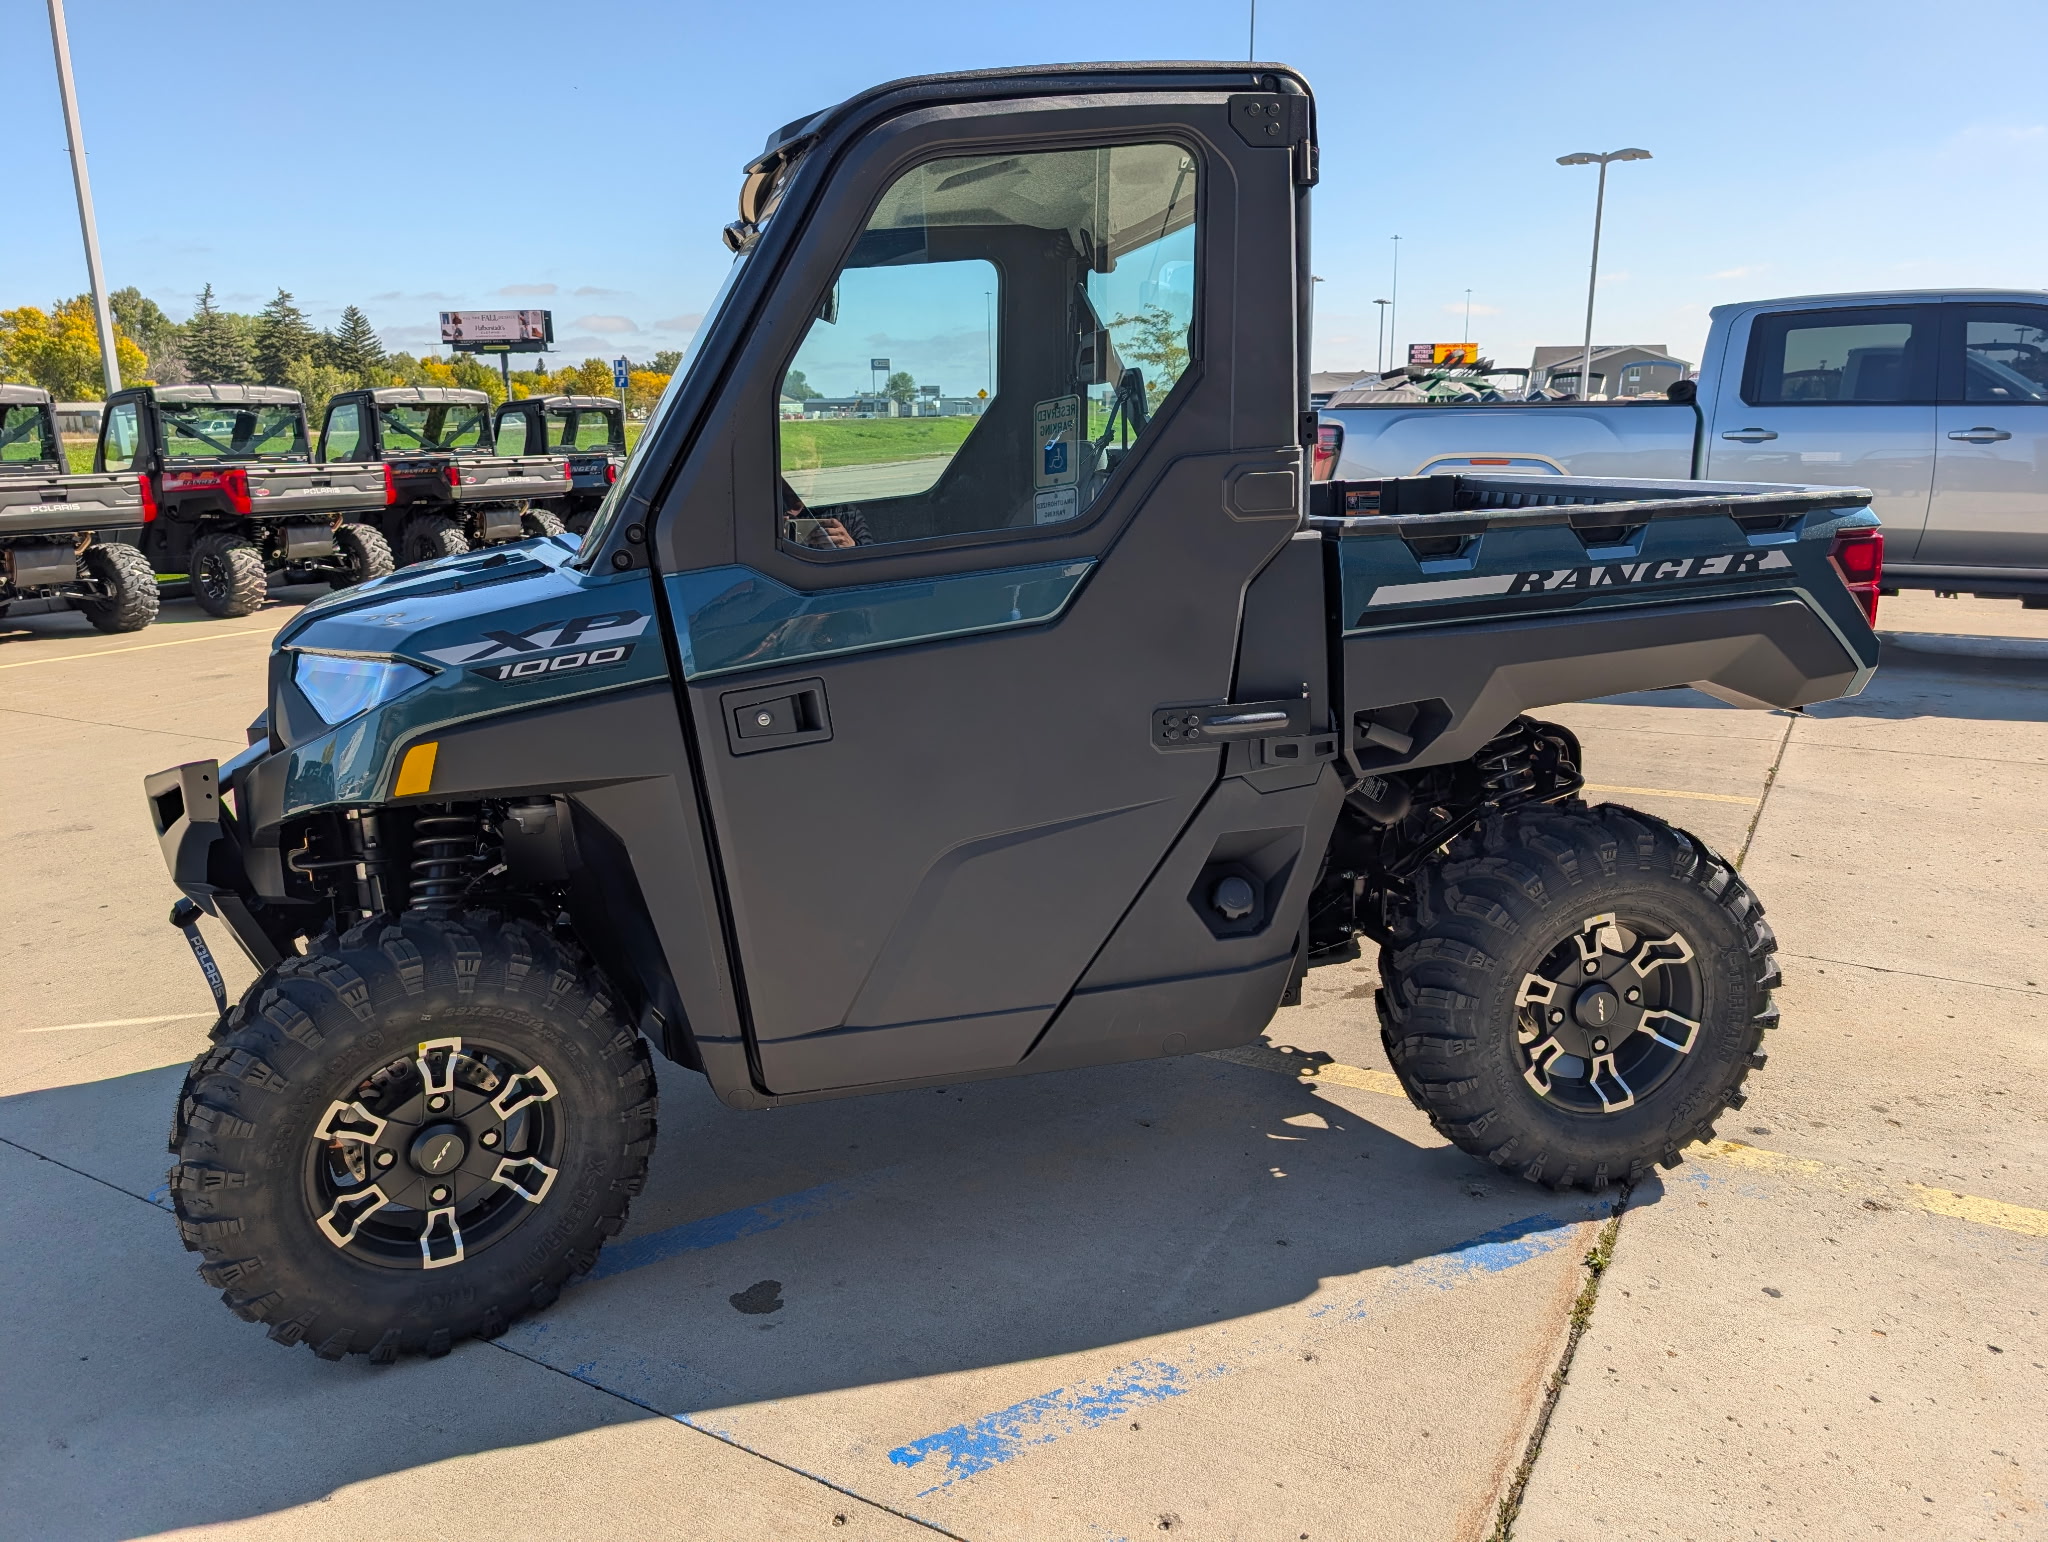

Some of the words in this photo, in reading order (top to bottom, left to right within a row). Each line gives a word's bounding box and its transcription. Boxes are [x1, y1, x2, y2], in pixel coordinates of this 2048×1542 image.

[481, 314, 499, 322] FALL
[615, 360, 626, 375] H
[182, 478, 220, 486] RANGER
[303, 486, 341, 495] POLARIS
[30, 503, 81, 513] POLARIS
[1505, 550, 1770, 596] RANGER
[458, 609, 645, 662] XP
[497, 646, 626, 680] 1000
[190, 935, 226, 998] POLARIS
